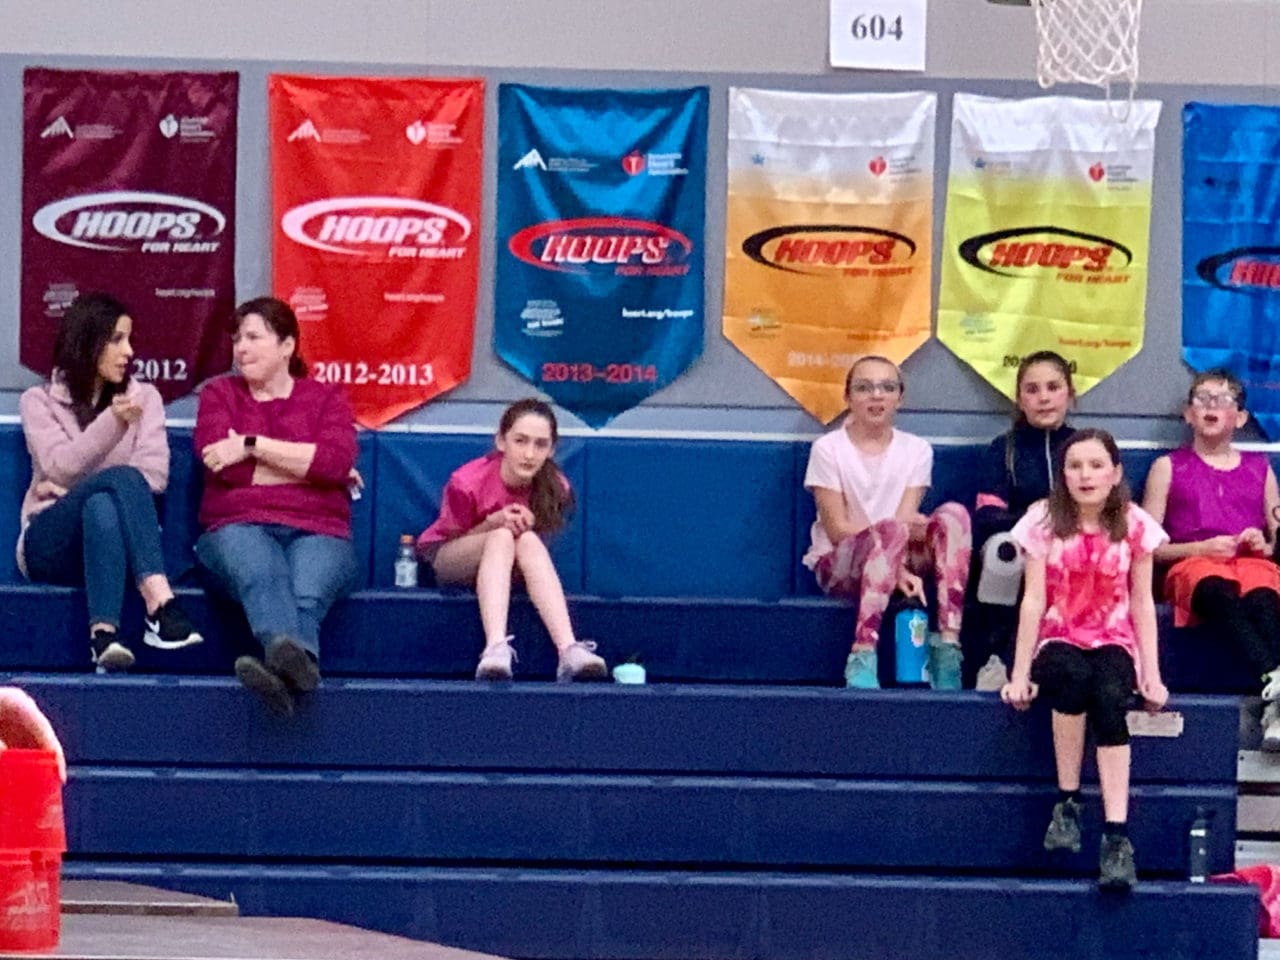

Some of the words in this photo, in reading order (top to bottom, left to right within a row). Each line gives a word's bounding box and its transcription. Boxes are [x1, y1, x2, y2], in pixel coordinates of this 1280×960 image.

[851, 15, 904, 41] 604
[73, 211, 201, 239] HOOPS
[318, 215, 448, 244] HOOPS
[540, 235, 669, 264] HOOPS
[773, 238, 897, 265] HOOPS
[989, 243, 1113, 272] HOOPS
[313, 361, 434, 385] 2012-2013
[542, 363, 657, 382] 2013-2014
